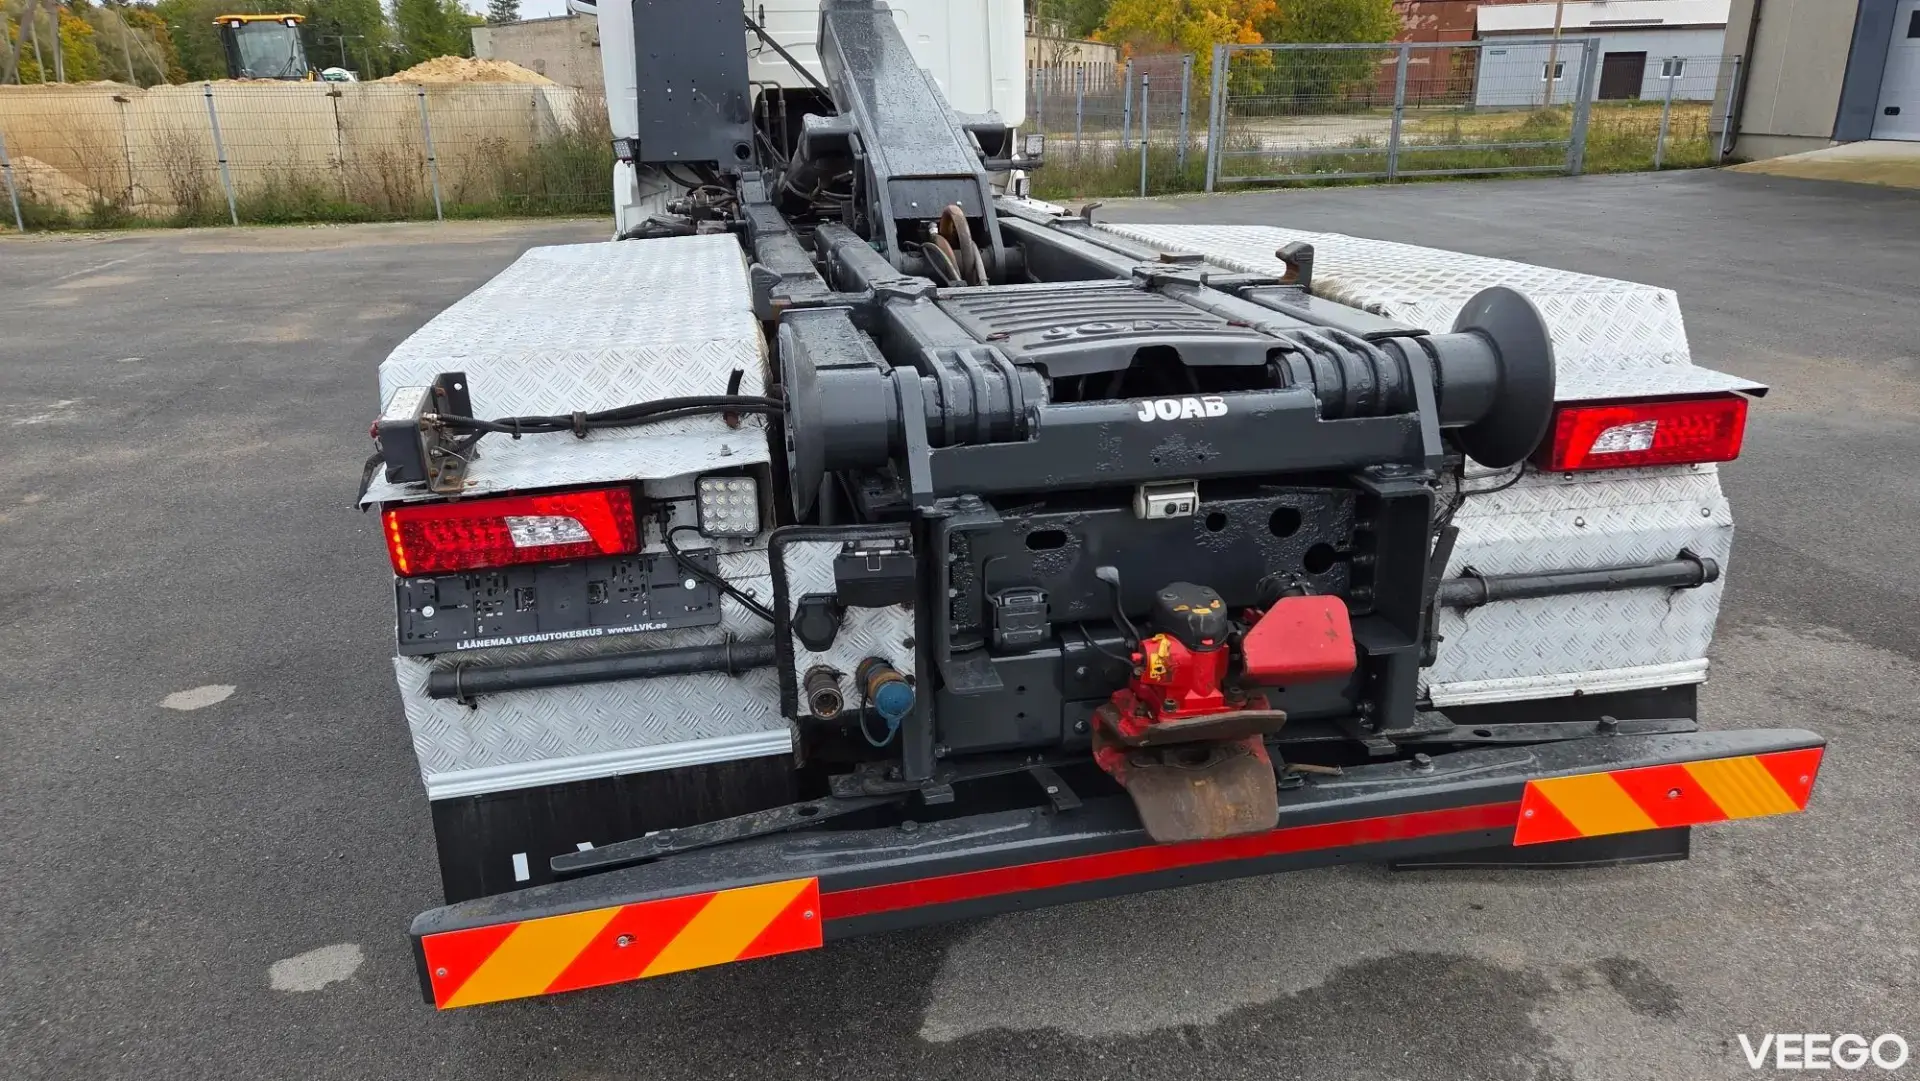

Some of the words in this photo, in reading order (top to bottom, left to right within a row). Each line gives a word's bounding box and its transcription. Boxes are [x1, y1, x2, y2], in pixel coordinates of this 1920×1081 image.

[1138, 396, 1228, 422] JOAB
[456, 636, 513, 650] LÄÄNEMAA
[515, 627, 603, 644] VEOAUTOKESKUS
[607, 622, 667, 635] www.LVK.ee
